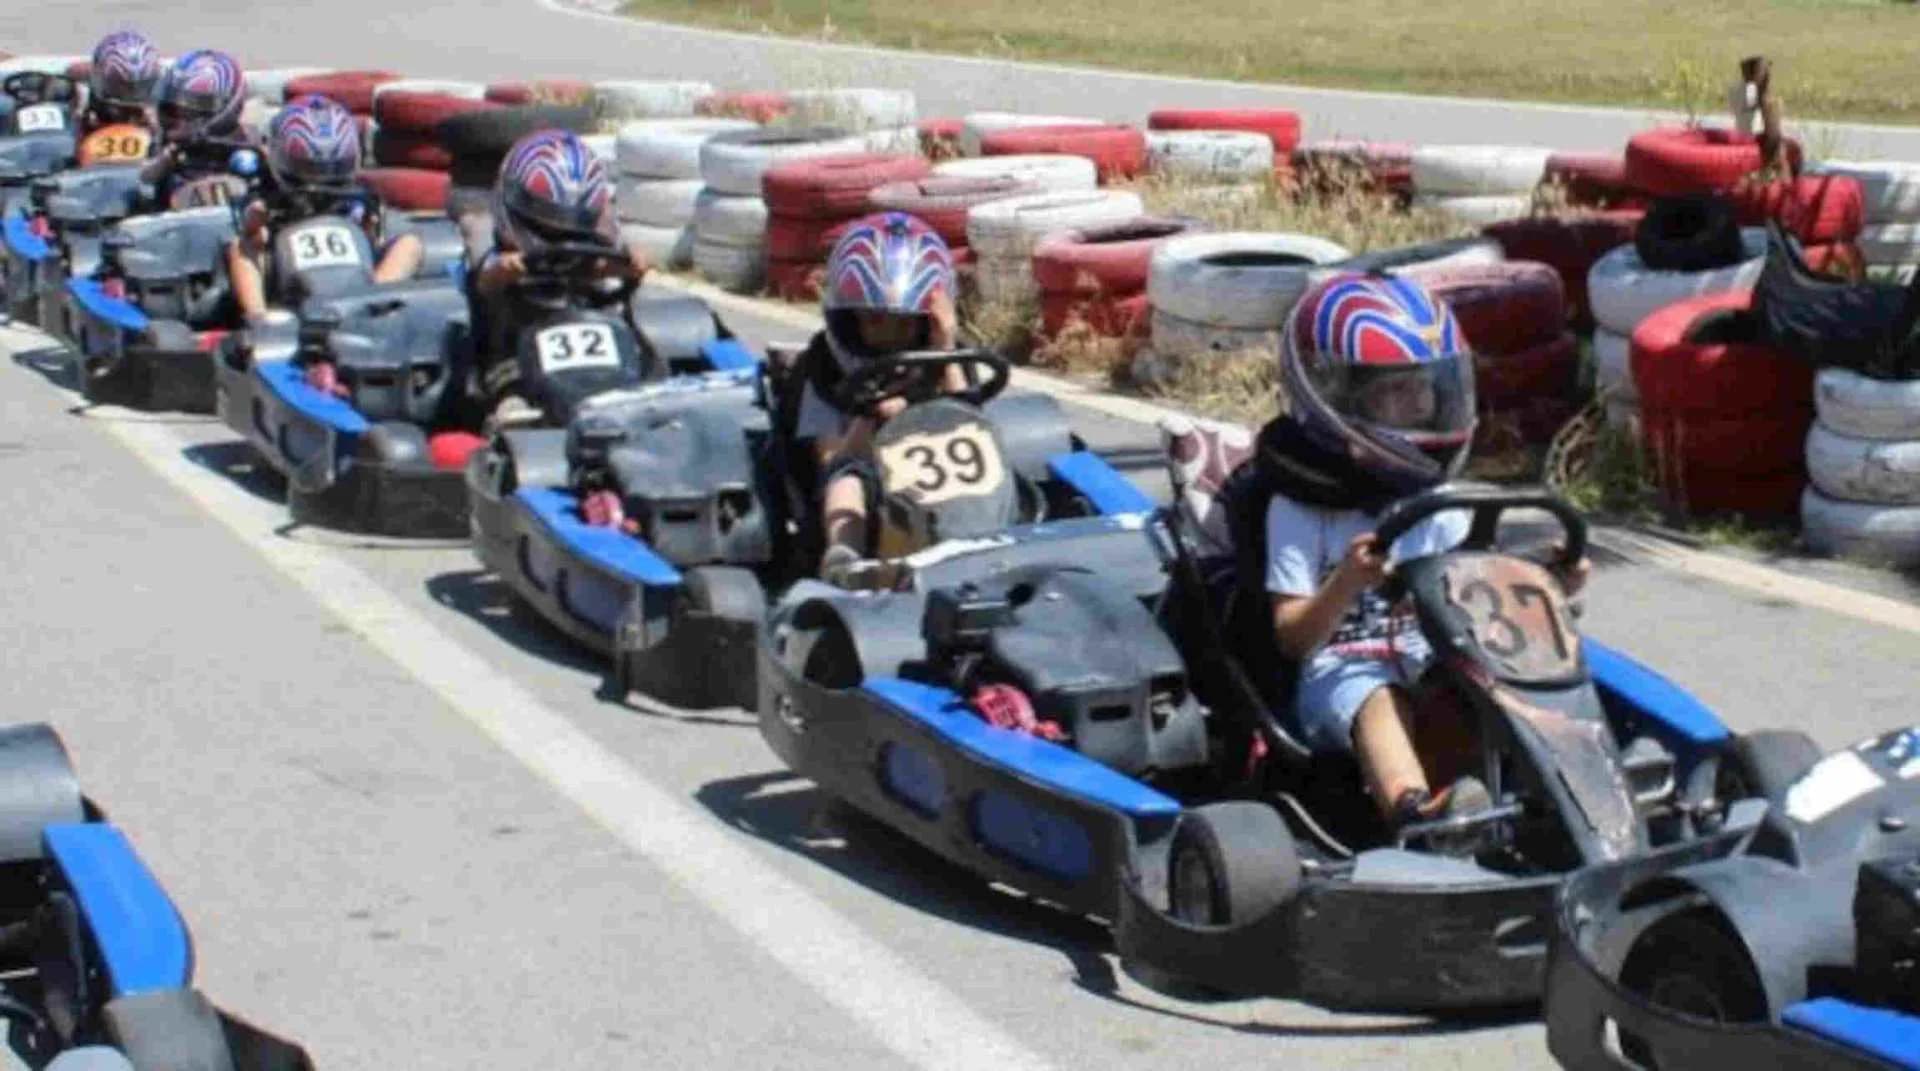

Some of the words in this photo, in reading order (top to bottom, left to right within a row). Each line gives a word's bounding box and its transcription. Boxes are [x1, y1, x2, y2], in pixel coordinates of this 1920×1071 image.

[100, 136, 140, 157] 30
[298, 231, 348, 259] 36
[549, 329, 606, 360] 32
[904, 436, 987, 491] 39
[1459, 578, 1569, 661] 37
